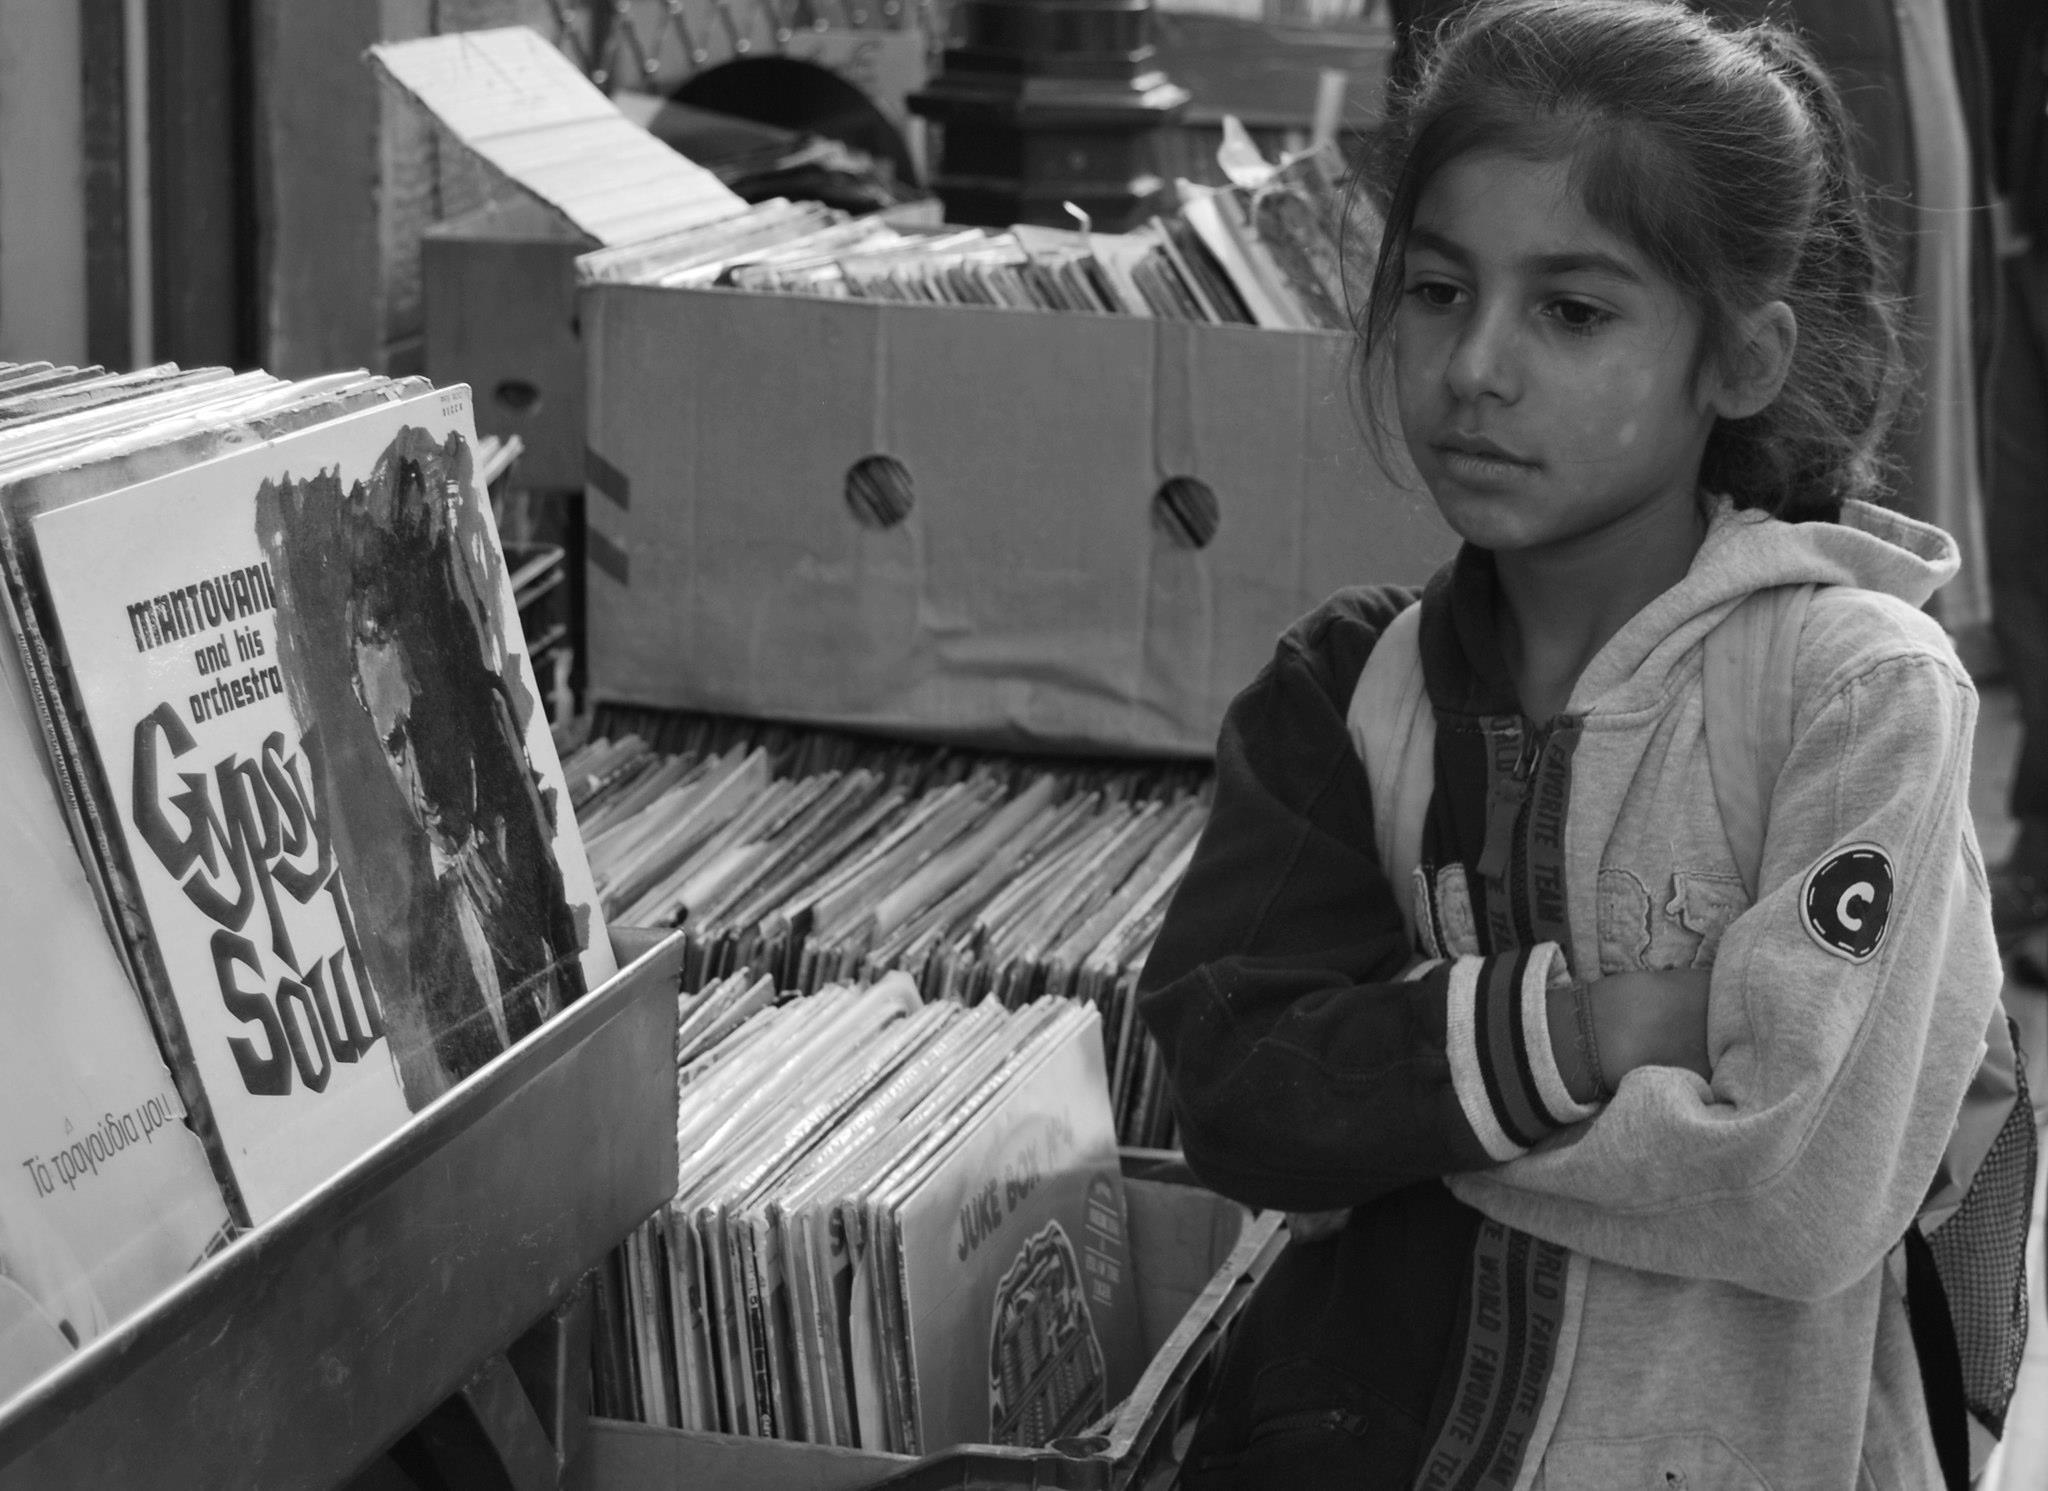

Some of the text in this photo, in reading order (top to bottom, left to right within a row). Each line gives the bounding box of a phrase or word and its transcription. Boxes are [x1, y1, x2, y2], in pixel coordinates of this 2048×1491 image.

[126, 562, 277, 653] MANTOVANI
[194, 625, 265, 676] and his
[189, 665, 284, 724] orchestra
[132, 701, 332, 979] Gypsy
[210, 864, 387, 1096] Soul
[51, 1112, 139, 1191] τραγούδια
[136, 1092, 173, 1144] μου
[958, 1176, 1002, 1262] JUKE
